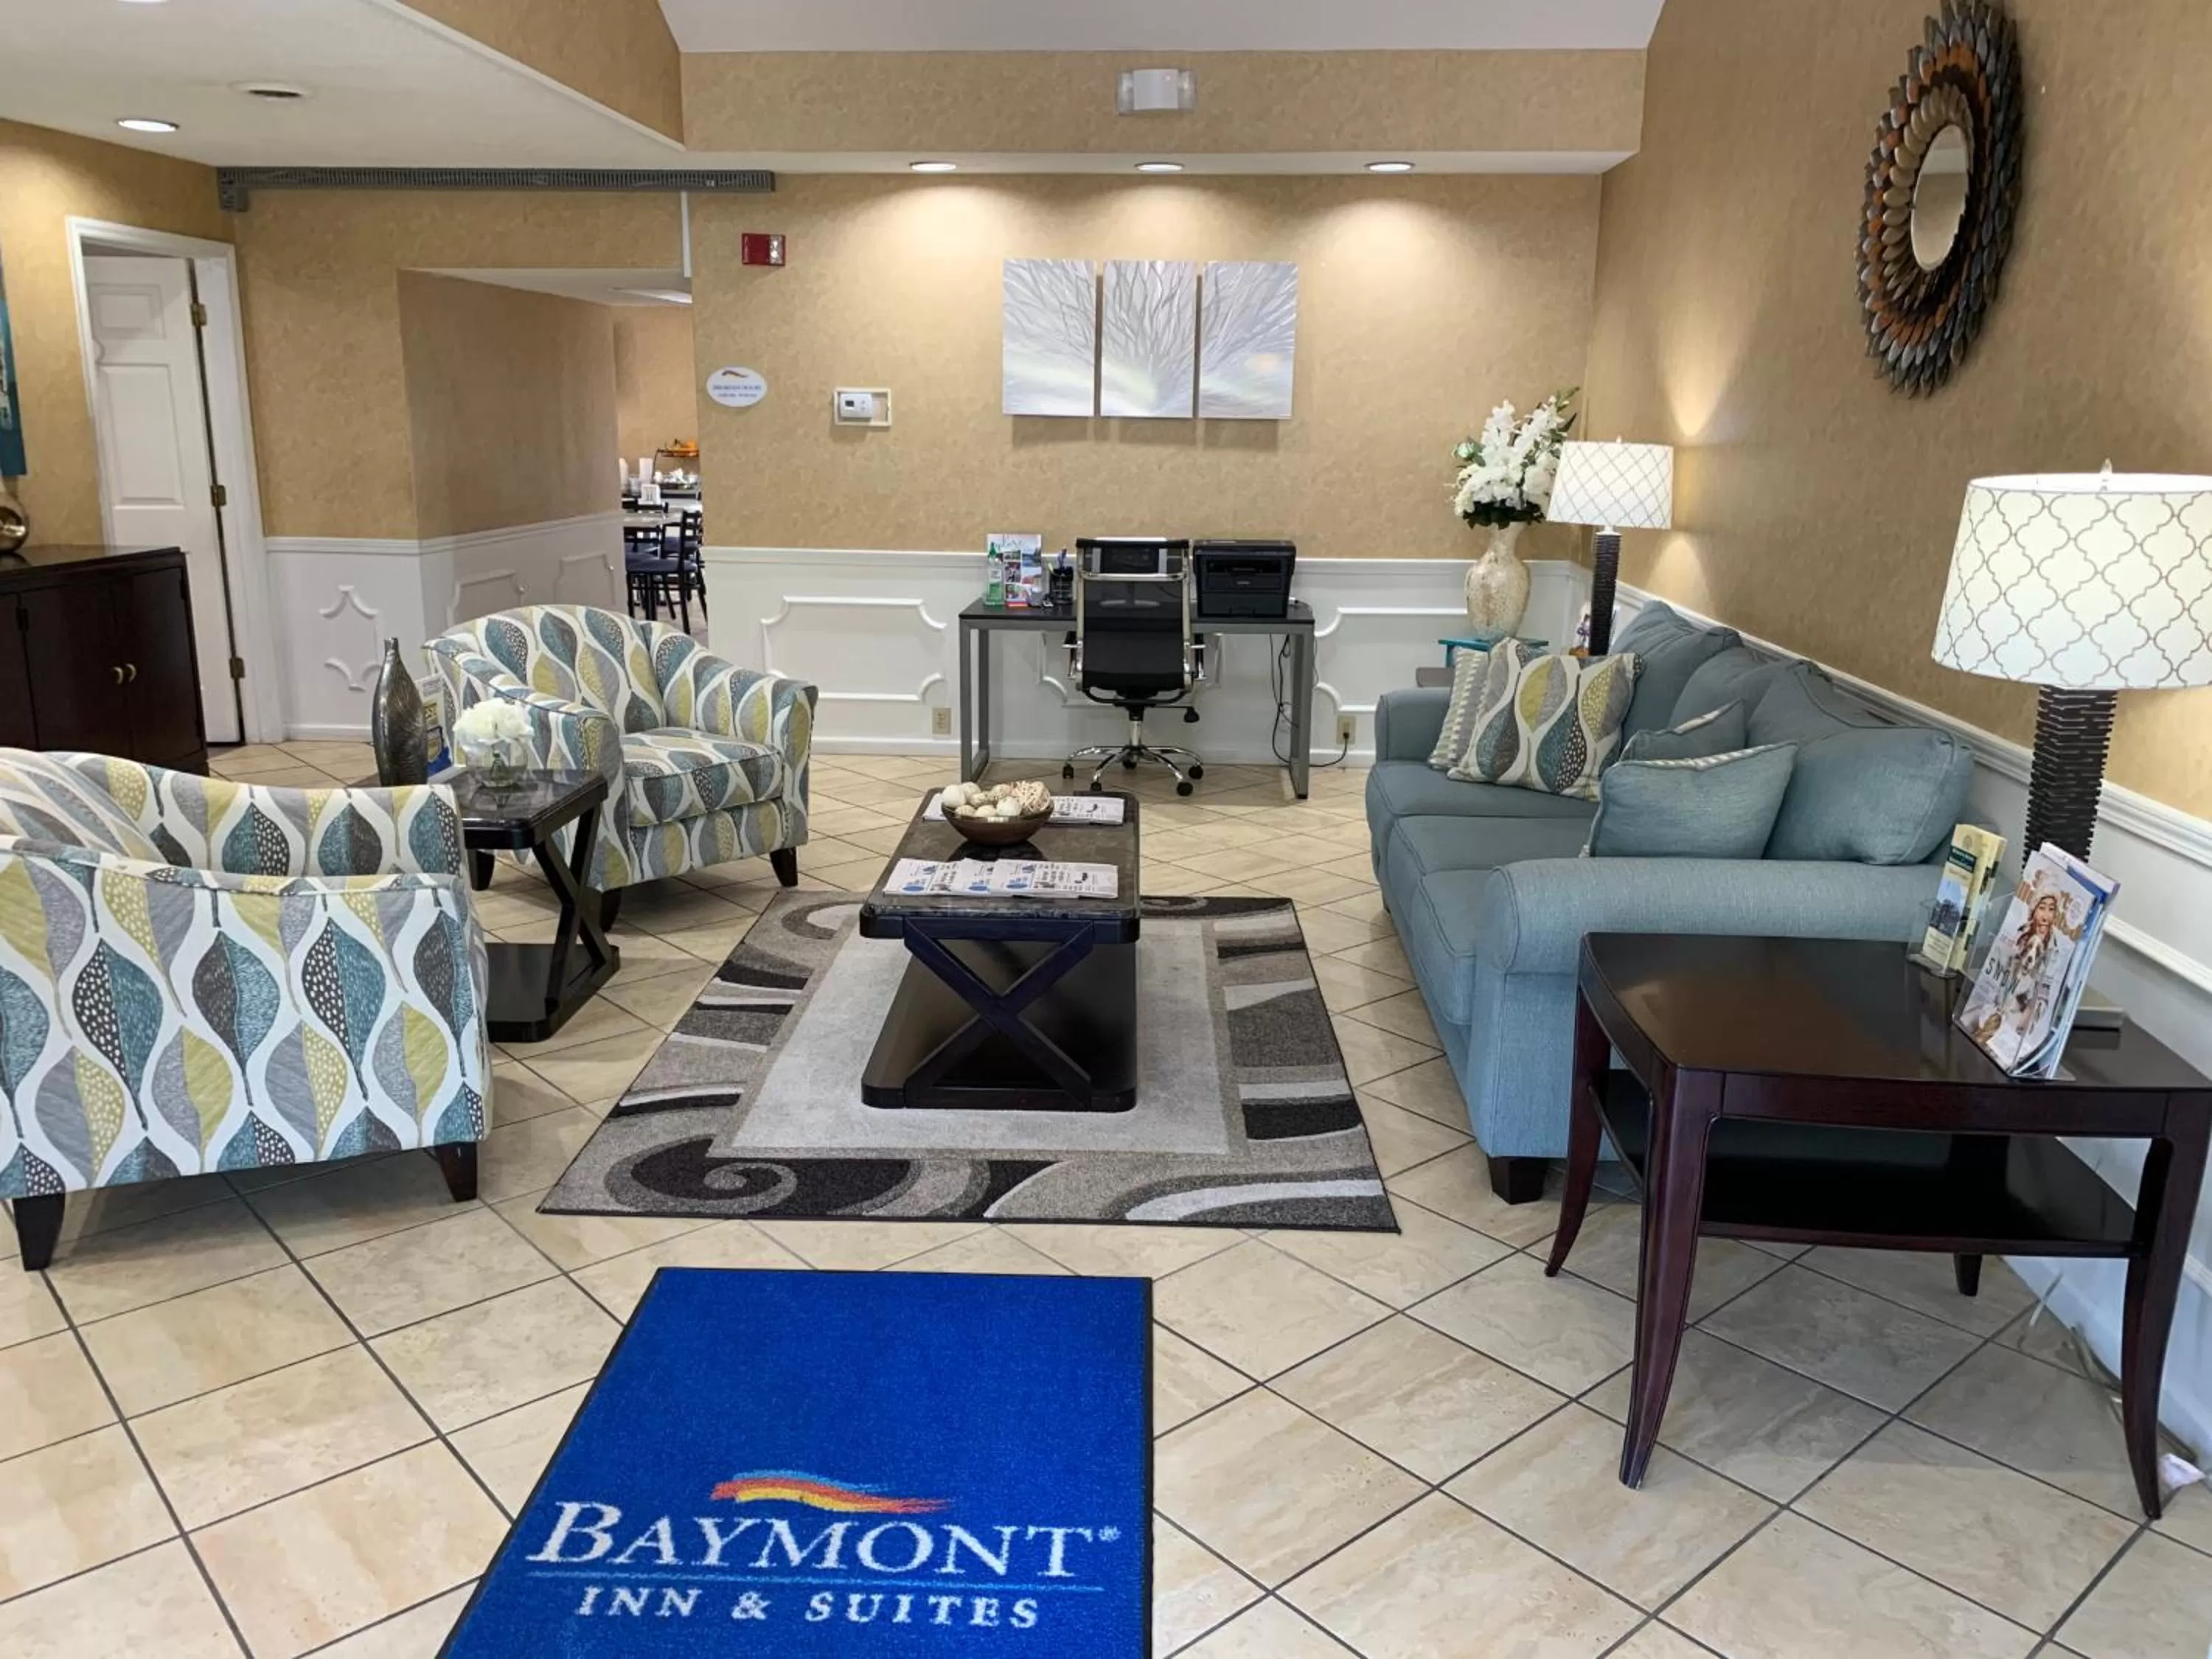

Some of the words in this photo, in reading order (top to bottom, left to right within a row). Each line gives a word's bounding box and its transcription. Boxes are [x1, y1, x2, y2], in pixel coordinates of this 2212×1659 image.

[525, 1500, 1094, 1577] BAYMONT
[577, 1586, 700, 1617] INN
[731, 1592, 769, 1620] &
[804, 1591, 1040, 1628] SUITES
